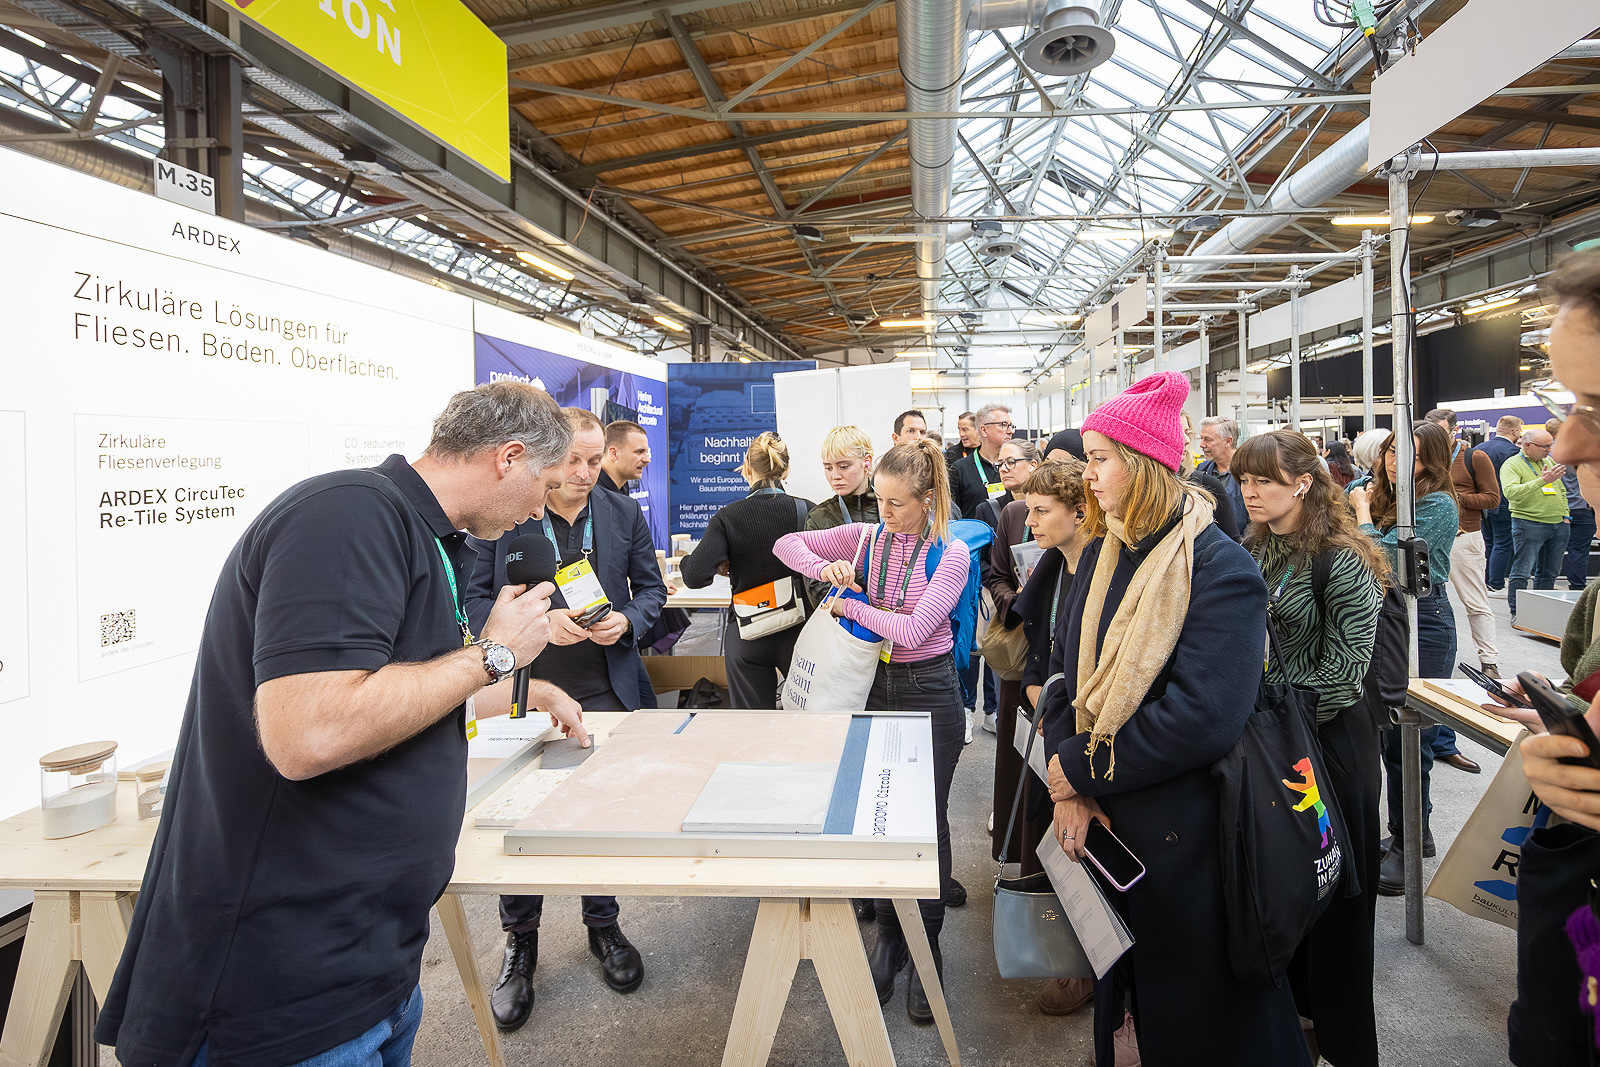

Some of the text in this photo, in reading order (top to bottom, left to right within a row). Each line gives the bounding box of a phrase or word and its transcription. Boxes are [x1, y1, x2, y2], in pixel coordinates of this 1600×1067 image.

[157, 162, 213, 197] M.35
[171, 222, 242, 255] ARDEX
[73, 271, 349, 346] Zirkuläre Lösungen für
[74, 312, 400, 381] Fliesen. Böden. Oberflächen.
[98, 433, 166, 450] Zirkuläre
[704, 436, 755, 448] Nachhalt
[98, 454, 223, 472] Fliesenverlegung
[700, 452, 741, 465] beginnt
[99, 488, 168, 508] ARDEX
[99, 506, 236, 529] Re-Tile System
